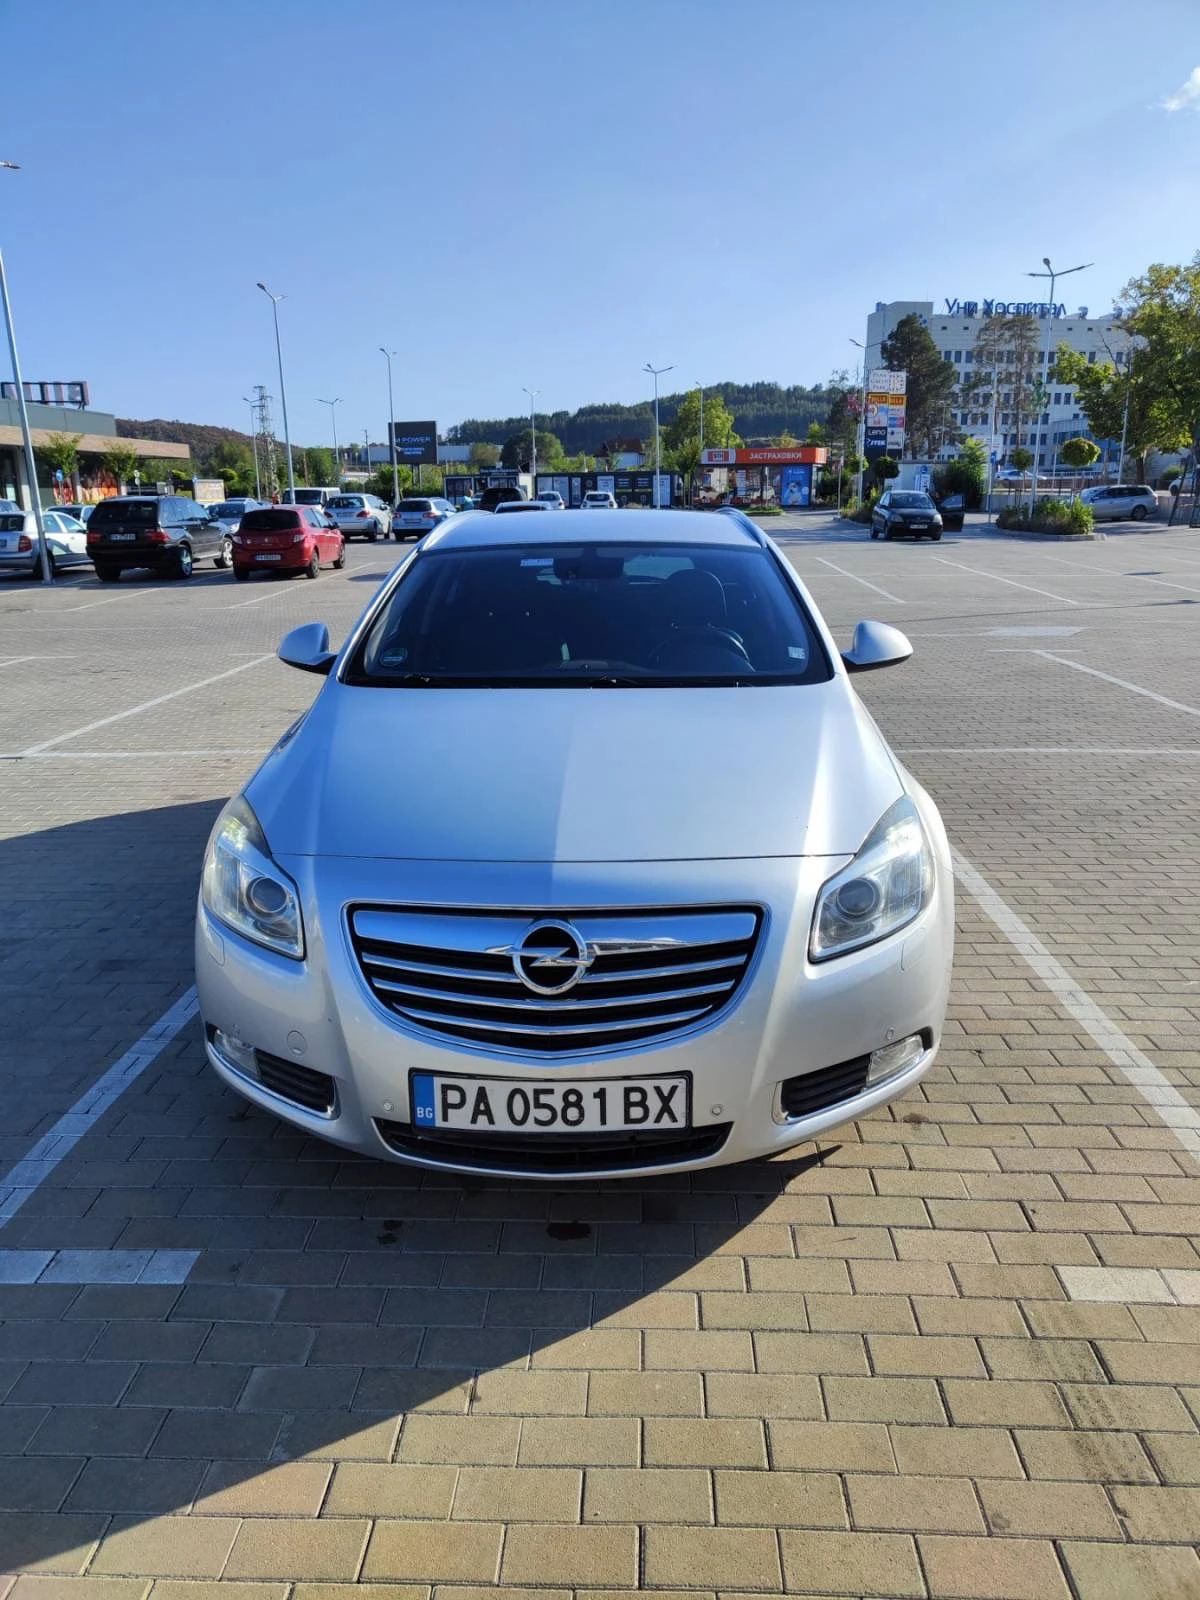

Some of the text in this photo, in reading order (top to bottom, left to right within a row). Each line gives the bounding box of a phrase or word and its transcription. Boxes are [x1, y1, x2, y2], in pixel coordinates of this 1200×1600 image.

[944, 298, 1067, 316] Уни Хоспитал
[750, 452, 802, 460] ЗАСТРАХОВКИ
[416, 1106, 433, 1119] BG
[441, 1083, 679, 1127] PA 0581 BX
